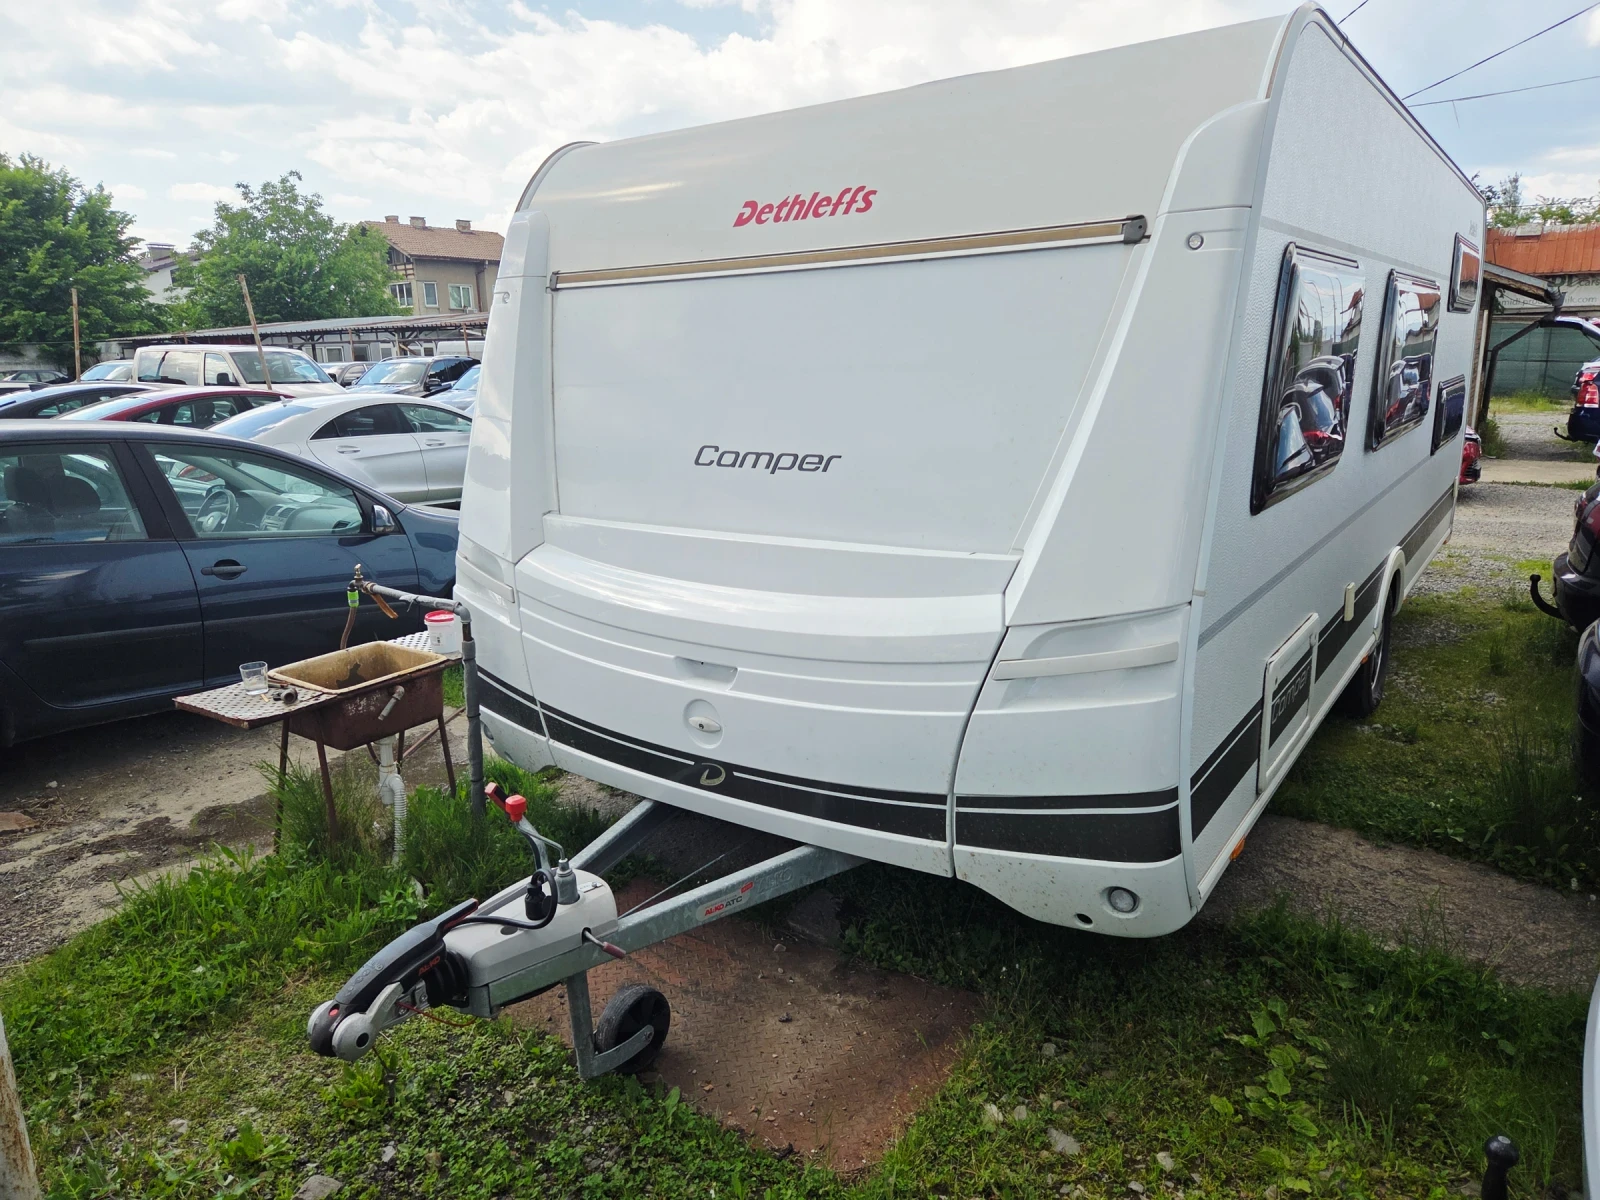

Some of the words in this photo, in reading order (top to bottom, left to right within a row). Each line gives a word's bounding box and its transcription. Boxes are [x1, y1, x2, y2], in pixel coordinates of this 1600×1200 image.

[732, 185, 878, 228] Dethleffs
[694, 444, 842, 475] Camper
[724, 895, 743, 909] ATC
